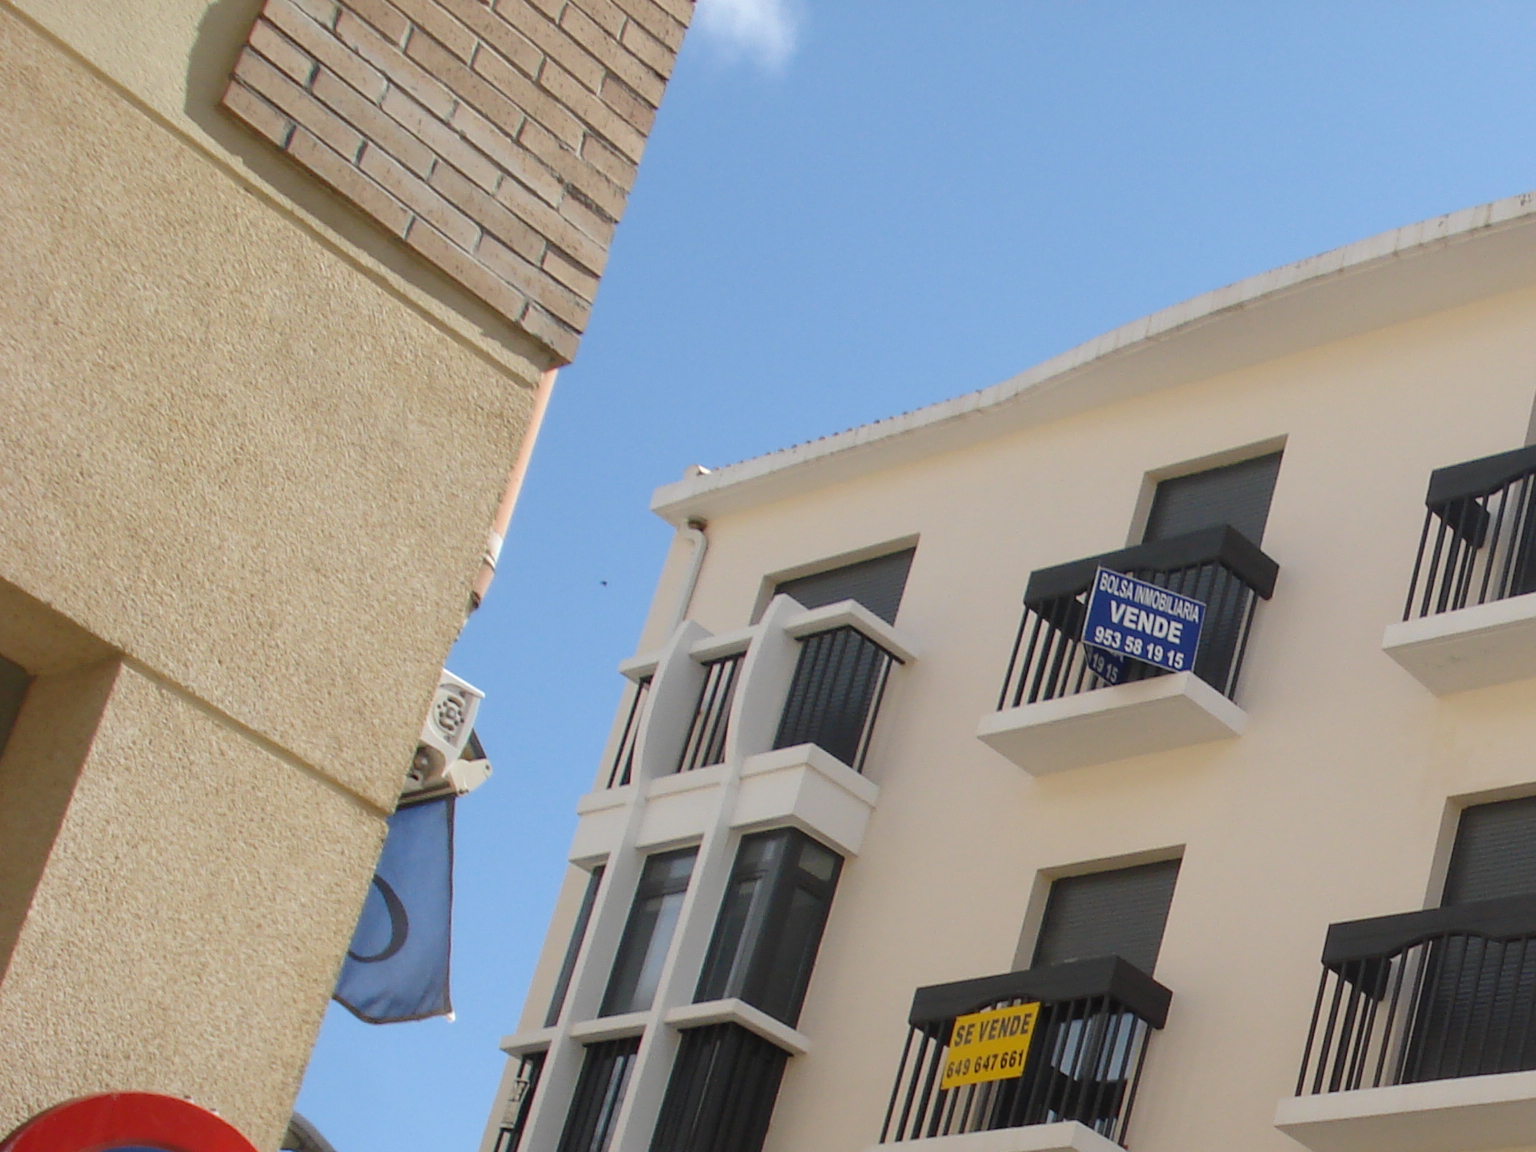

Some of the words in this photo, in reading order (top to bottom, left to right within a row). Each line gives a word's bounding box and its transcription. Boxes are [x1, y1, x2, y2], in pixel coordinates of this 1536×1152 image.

[1100, 573, 1133, 599] BOLSA
[1134, 584, 1199, 624] INMOBILIARIA
[1110, 600, 1183, 644] VENDE
[1094, 626, 1121, 648] 953
[1124, 636, 1143, 655] 58
[1147, 643, 1163, 662] 19
[1167, 650, 1185, 669] 15
[954, 1023, 975, 1047] SE
[978, 1013, 1032, 1042] VENDE
[946, 1058, 971, 1079] 649
[974, 1053, 999, 1073] 647
[1000, 1049, 1024, 1069] 661
